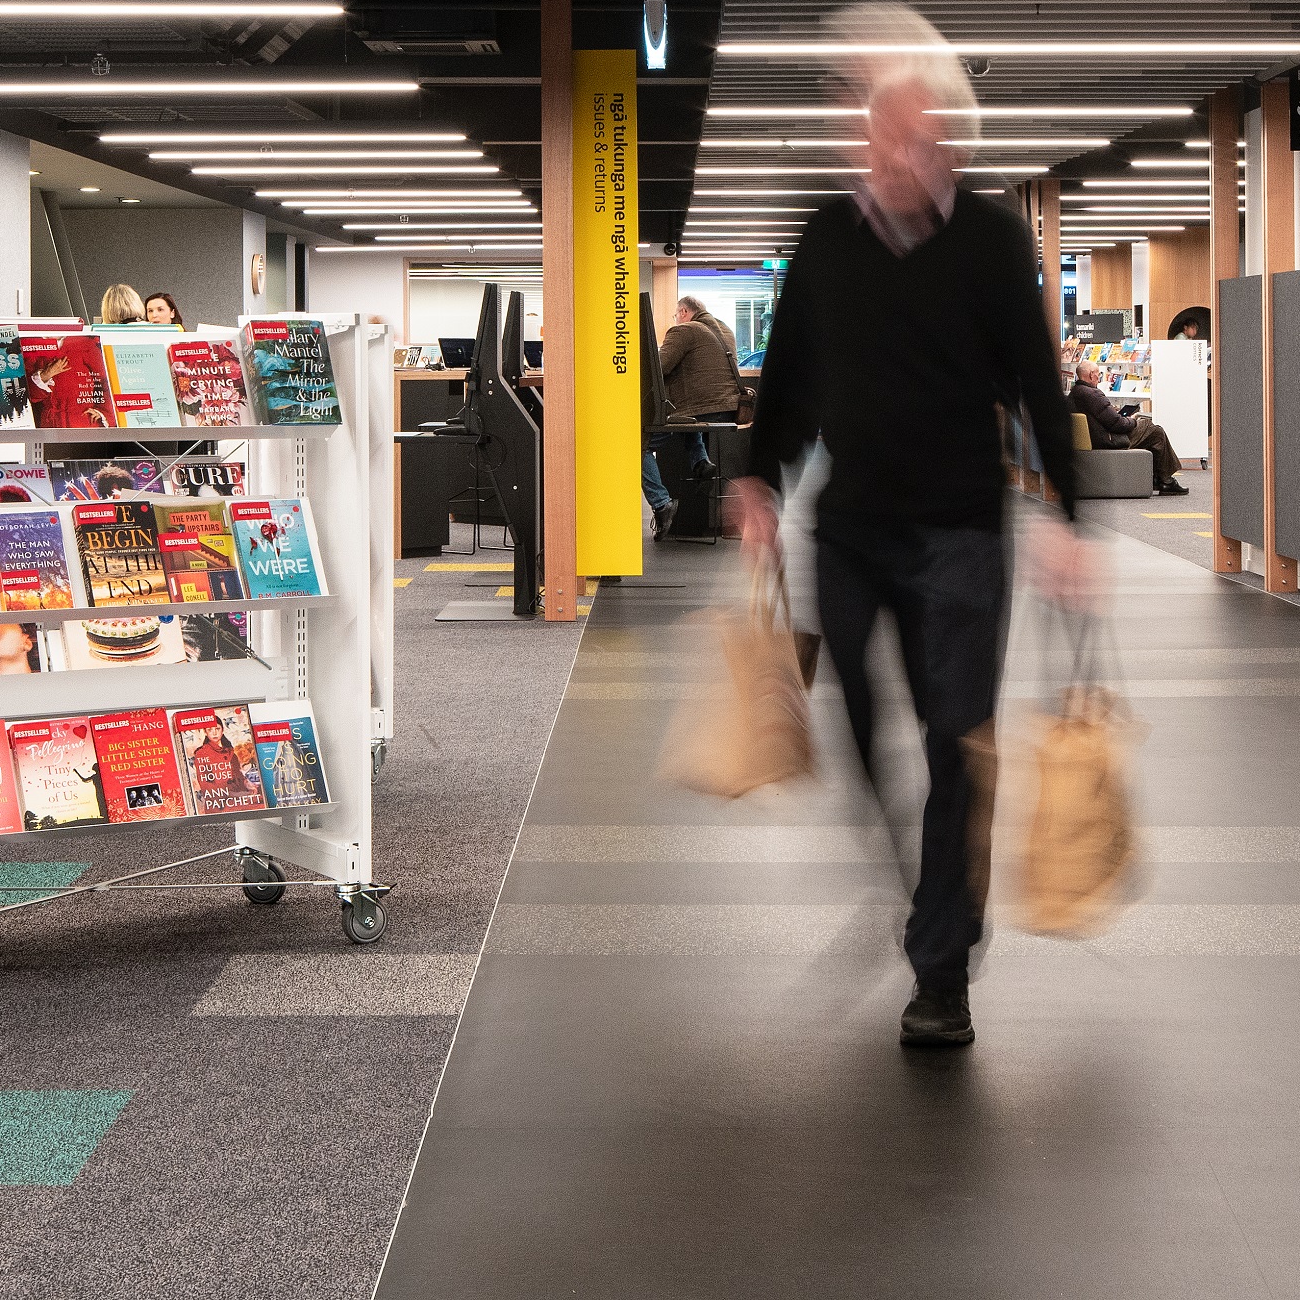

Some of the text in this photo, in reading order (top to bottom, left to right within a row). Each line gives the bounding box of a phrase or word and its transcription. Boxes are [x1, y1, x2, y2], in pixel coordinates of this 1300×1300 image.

[593, 93, 608, 213] issues & returns
[610, 93, 630, 375] ngā tukunga me ngā whakahokinga
[1076, 323, 1094, 331] tamariki
[175, 348, 208, 356] BESTSELLERS
[274, 345, 322, 358] Mantel
[188, 366, 231, 375] MINUTE
[302, 358, 324, 373] The
[191, 379, 234, 388] CRYING
[287, 376, 328, 387] Mirror
[300, 402, 333, 419] Light
[79, 510, 114, 519] BESTSELLERS
[237, 508, 269, 516] BESTSELLERS
[187, 524, 220, 533] UPSTAIRS
[85, 528, 152, 551] BEGIN
[5, 560, 61, 570] EVERYTHING
[94, 720, 129, 731] BESTSELLERS
[257, 728, 290, 738] BESTSELLERS
